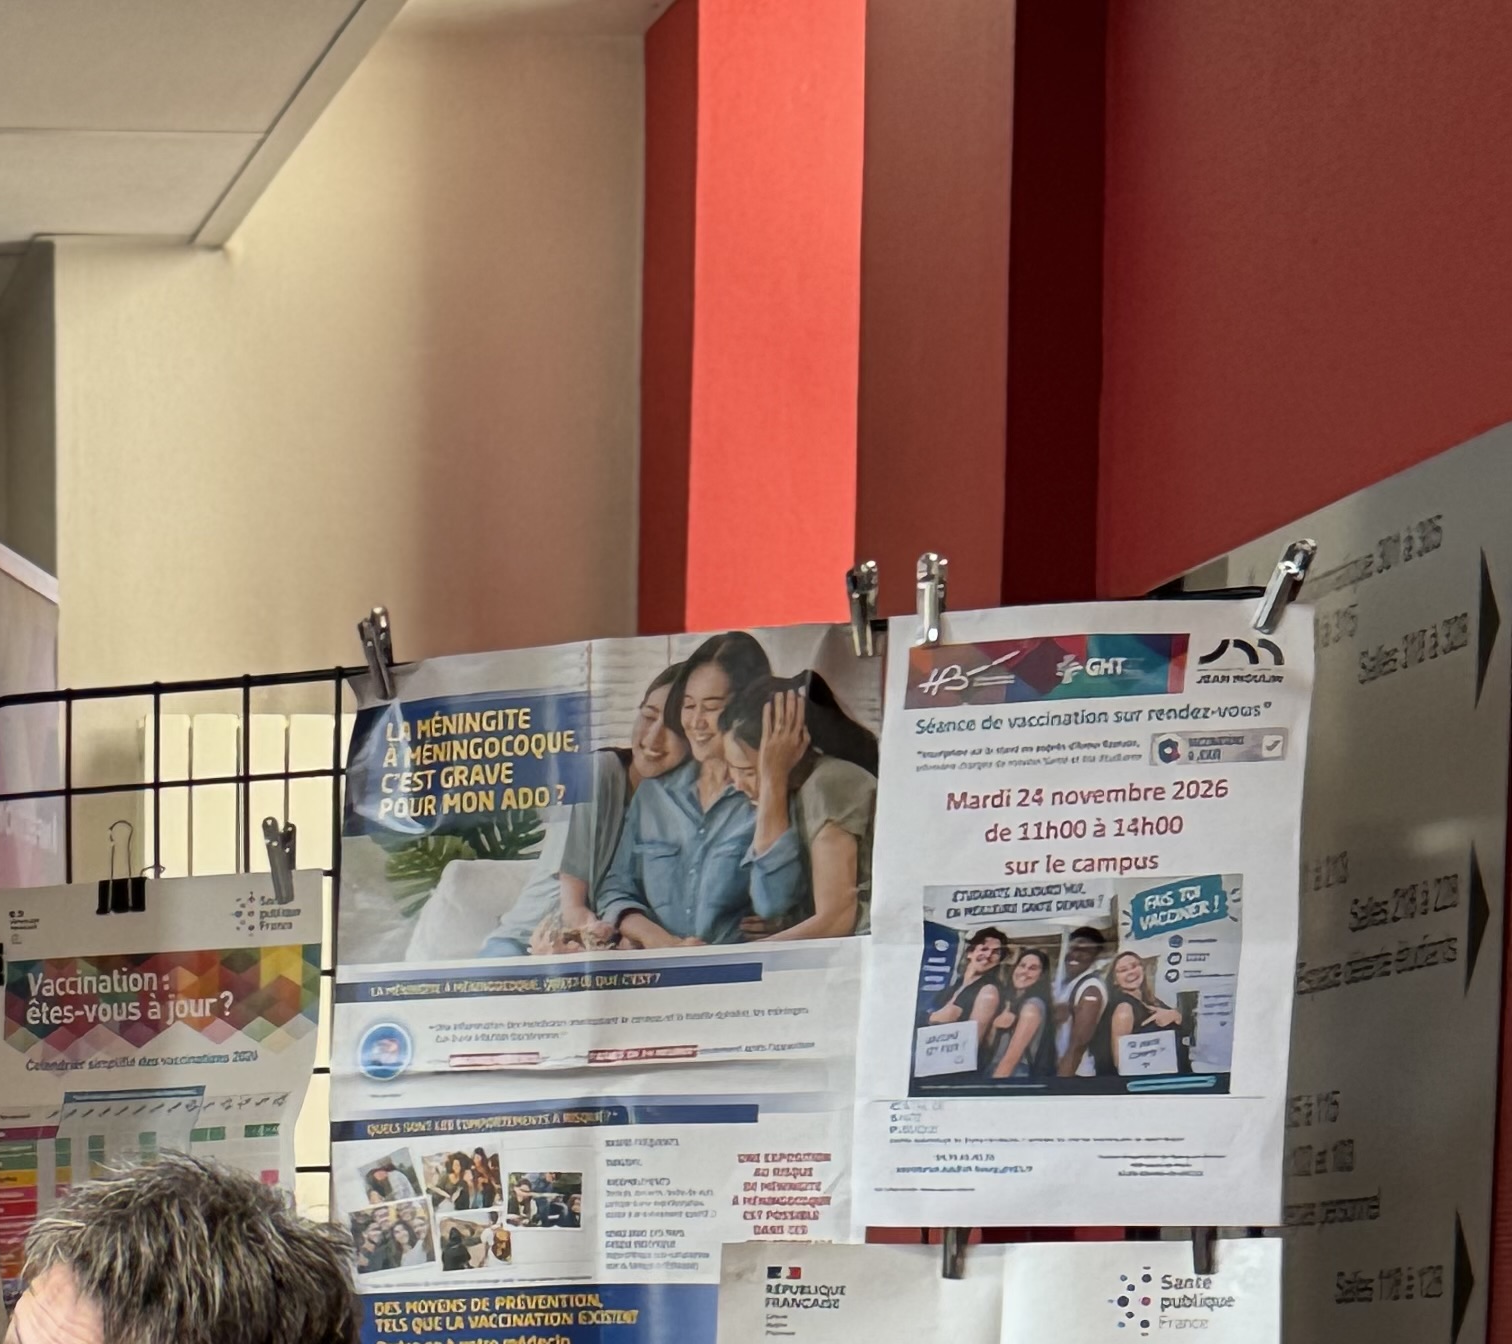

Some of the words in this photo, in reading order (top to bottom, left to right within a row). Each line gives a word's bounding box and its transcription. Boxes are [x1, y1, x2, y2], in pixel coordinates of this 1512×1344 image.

[1086, 656, 1128, 677] GHT
[385, 720, 412, 742] LA
[417, 708, 532, 740] MÉNINGITE
[915, 717, 977, 736] Séance
[981, 714, 1003, 731] de
[1008, 708, 1109, 730] vaccination
[1113, 708, 1143, 723] sur
[382, 743, 398, 768] À
[403, 730, 580, 768] MÉNINGOCOQUE,
[381, 769, 437, 794] C'EST
[440, 762, 514, 789] GRAVE
[378, 794, 436, 820] POUR
[441, 790, 495, 815] MON
[500, 786, 550, 810] ADO
[554, 784, 566, 806] ?
[946, 789, 1012, 811] Mardi
[1016, 787, 1044, 808] 24
[1050, 782, 1166, 807] novembre
[1171, 779, 1229, 801] 2026
[984, 823, 1012, 843] de
[1017, 819, 1087, 842] 11h00
[1092, 817, 1106, 838] à
[1113, 815, 1184, 837] 14h00
[1004, 858, 1040, 876] sur
[1045, 854, 1066, 874] le
[1071, 853, 1159, 876] campus
[27, 966, 158, 997] Vaccination
[26, 997, 141, 1025] êtes-vous
[148, 992, 161, 1019] à
[166, 993, 217, 1025] jour
[219, 989, 234, 1016] ?
[1159, 1274, 1212, 1290] Santé
[374, 1301, 402, 1316] DES
[470, 1297, 490, 1312] DE
[1159, 1294, 1236, 1312] publique
[375, 1318, 408, 1333] TELS
[411, 1316, 443, 1335] QUE
[445, 1316, 465, 1331] LA
[467, 1312, 573, 1330] VACCINATION
[1158, 1316, 1209, 1330] France
